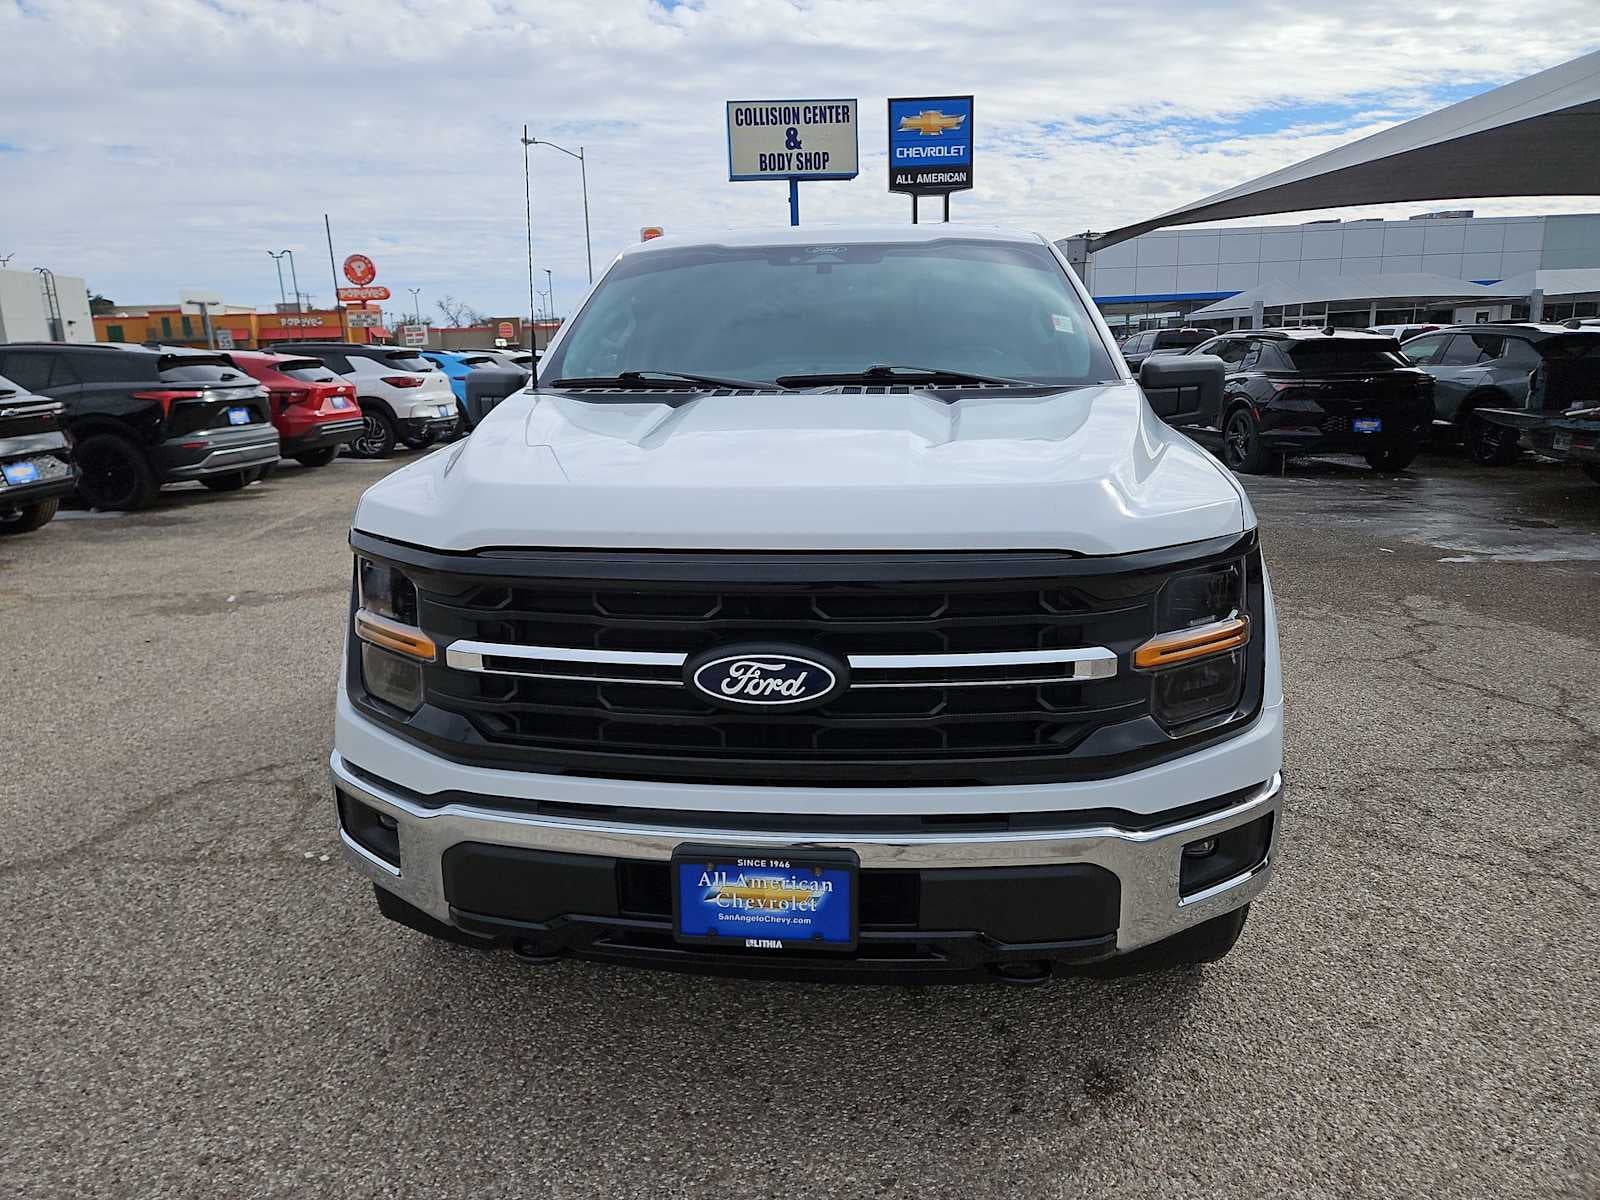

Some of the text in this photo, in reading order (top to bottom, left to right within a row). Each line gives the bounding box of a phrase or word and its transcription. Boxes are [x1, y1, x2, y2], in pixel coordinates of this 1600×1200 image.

[735, 105, 850, 126] COLLISION CENTER
[784, 127, 802, 150] &
[759, 151, 830, 171] BODY SHOP
[896, 145, 966, 158] CHEVROLET
[895, 171, 967, 184] ALL AMERICAN
[721, 660, 808, 697] Ford
[737, 859, 791, 869] SINCE 1946
[698, 871, 834, 893] All American
[715, 892, 818, 912] Chevrolet
[718, 913, 812, 925] SanAngeloChevy.com
